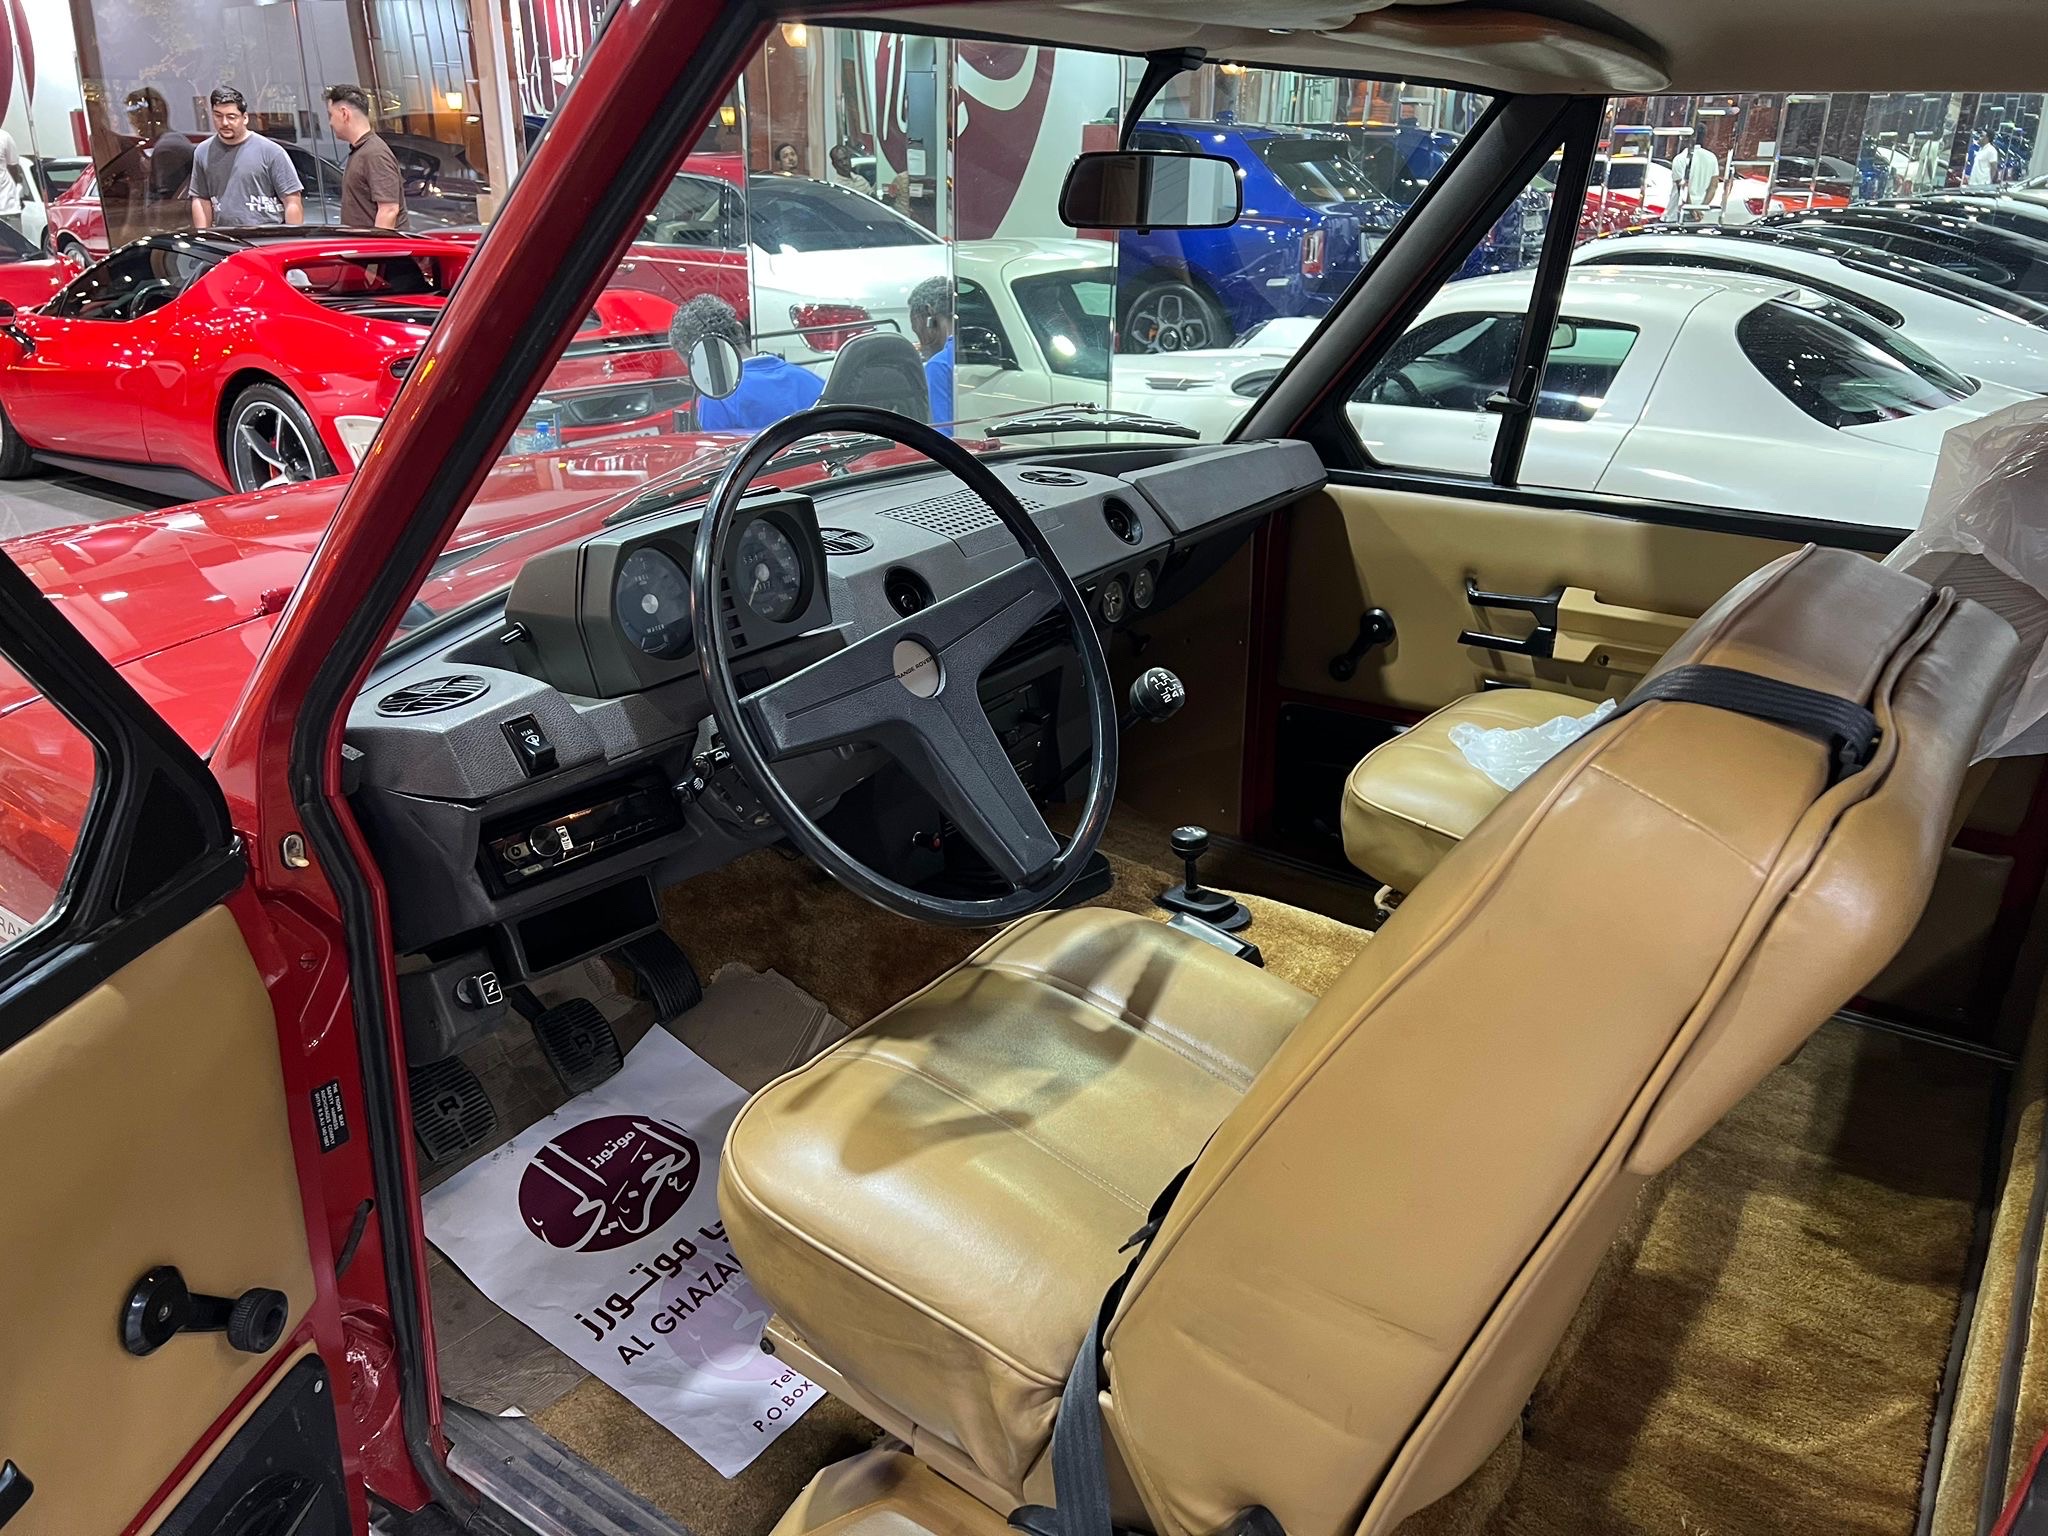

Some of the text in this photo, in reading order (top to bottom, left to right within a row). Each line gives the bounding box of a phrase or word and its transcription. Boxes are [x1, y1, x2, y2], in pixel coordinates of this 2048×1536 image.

[250, 194, 277, 205] NEW
[331, 1107, 339, 1131] HARNESS
[327, 1124, 336, 1145] COMPLY
[587, 1131, 636, 1169] موتورز
[617, 1335, 655, 1365] AL
[752, 1380, 813, 1433] P.O.Box
